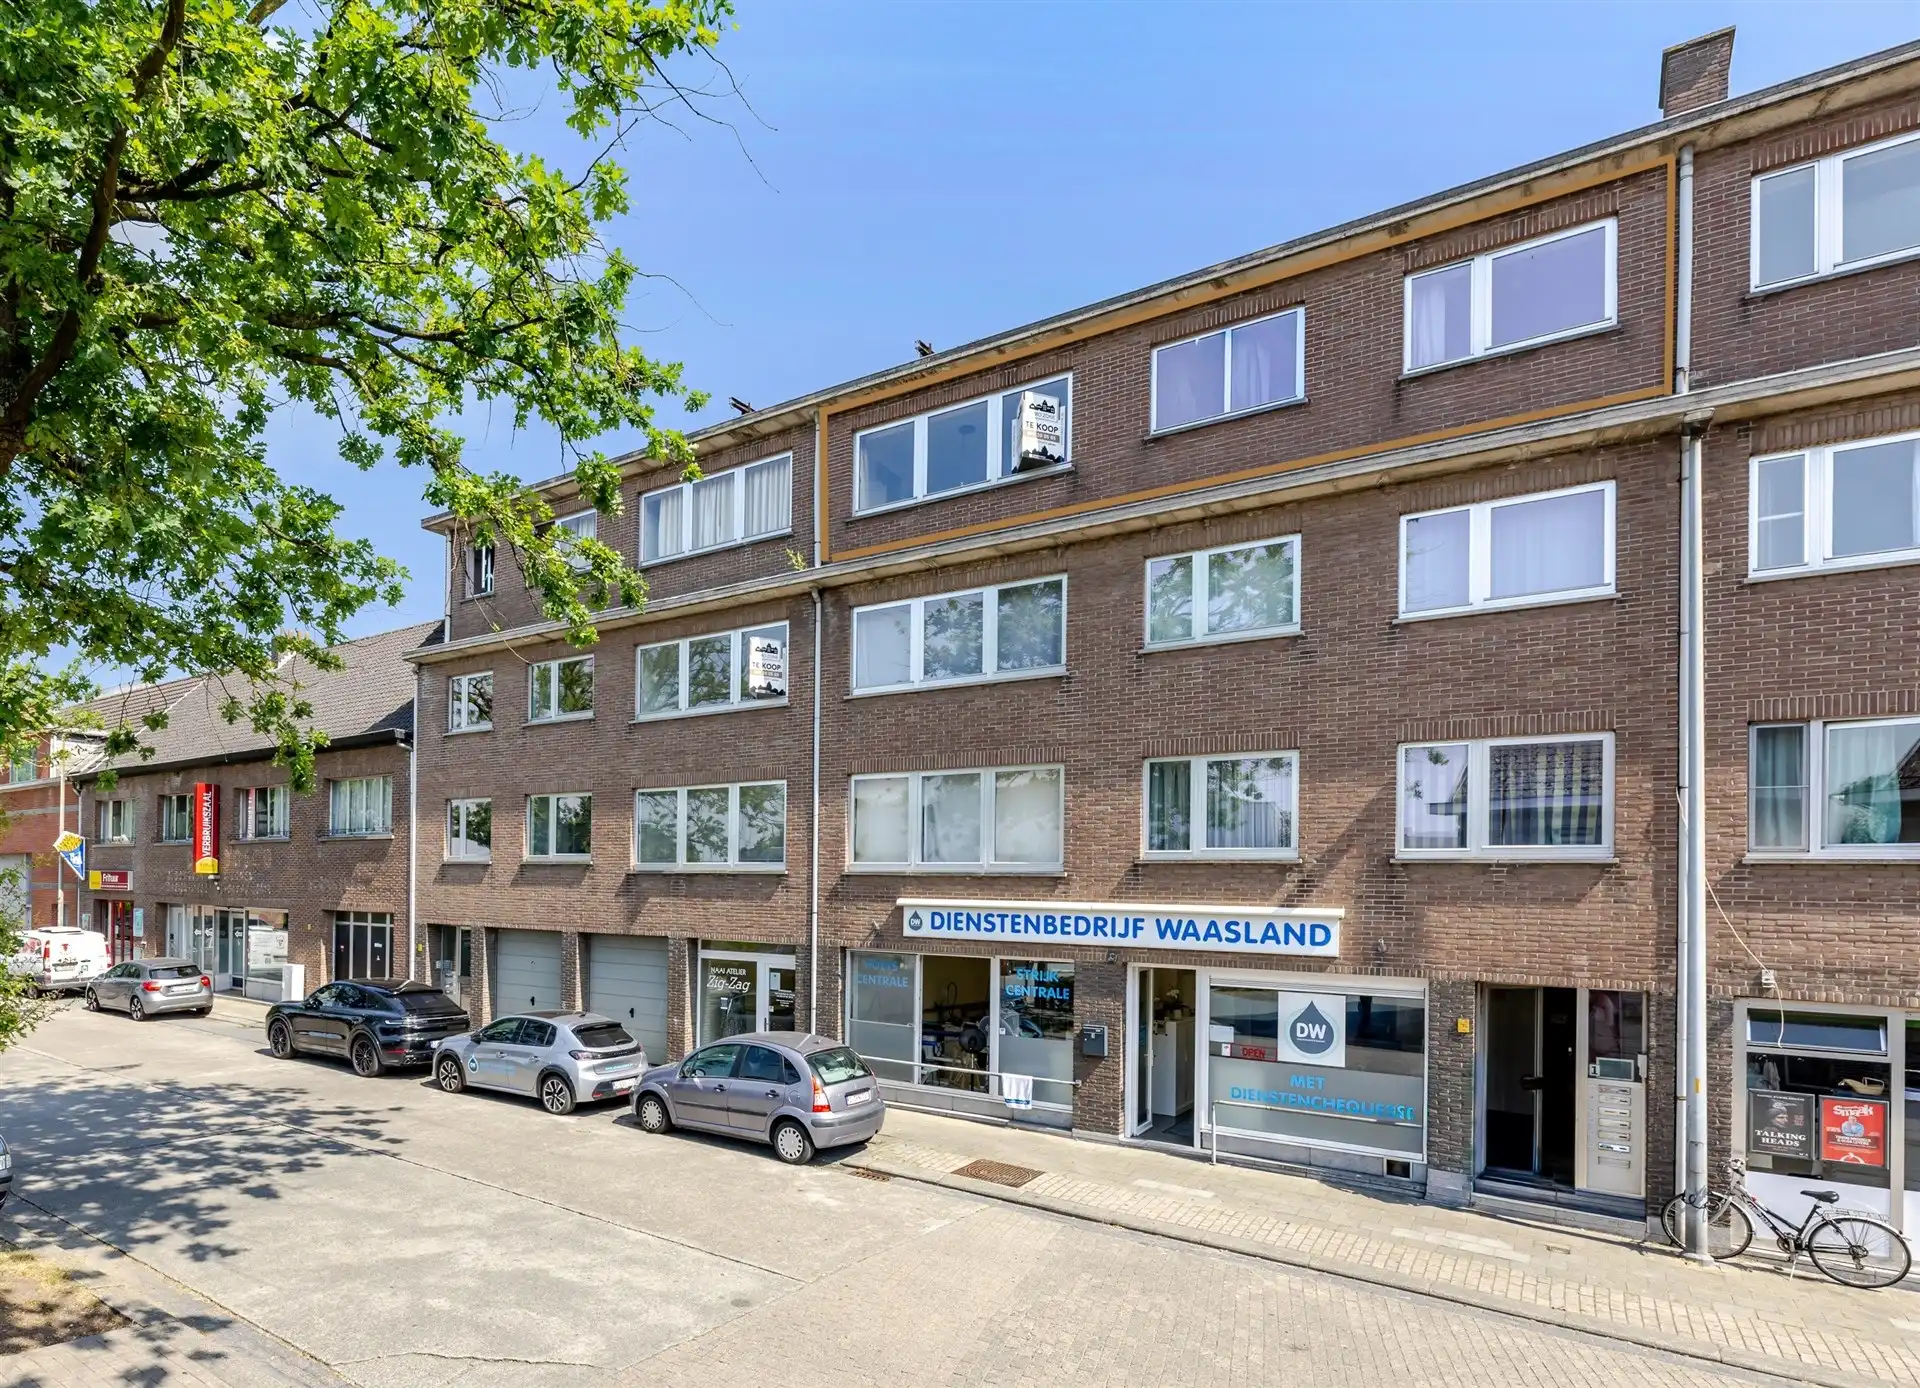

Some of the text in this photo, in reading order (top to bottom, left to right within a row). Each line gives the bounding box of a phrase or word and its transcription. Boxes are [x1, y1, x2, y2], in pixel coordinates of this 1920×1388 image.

[1025, 420, 1059, 433] TE KOOP
[761, 662, 782, 670] KOOP
[201, 791, 212, 857] VERBRUIKSZAAL
[930, 911, 1332, 947] DIENSTENBEDRIJF WAASLAND
[710, 966, 747, 976] NAAI ATELIER
[1016, 967, 1060, 982] STRIJK
[706, 974, 751, 993] Zig-Zag
[1005, 983, 1070, 1000] CENTRALE
[1296, 1022, 1327, 1040] DW
[1241, 1047, 1266, 1058] OPEN
[1290, 1074, 1326, 1090] MET
[1754, 1129, 1807, 1141] TALKING
[1761, 1136, 1800, 1147] HEADS
